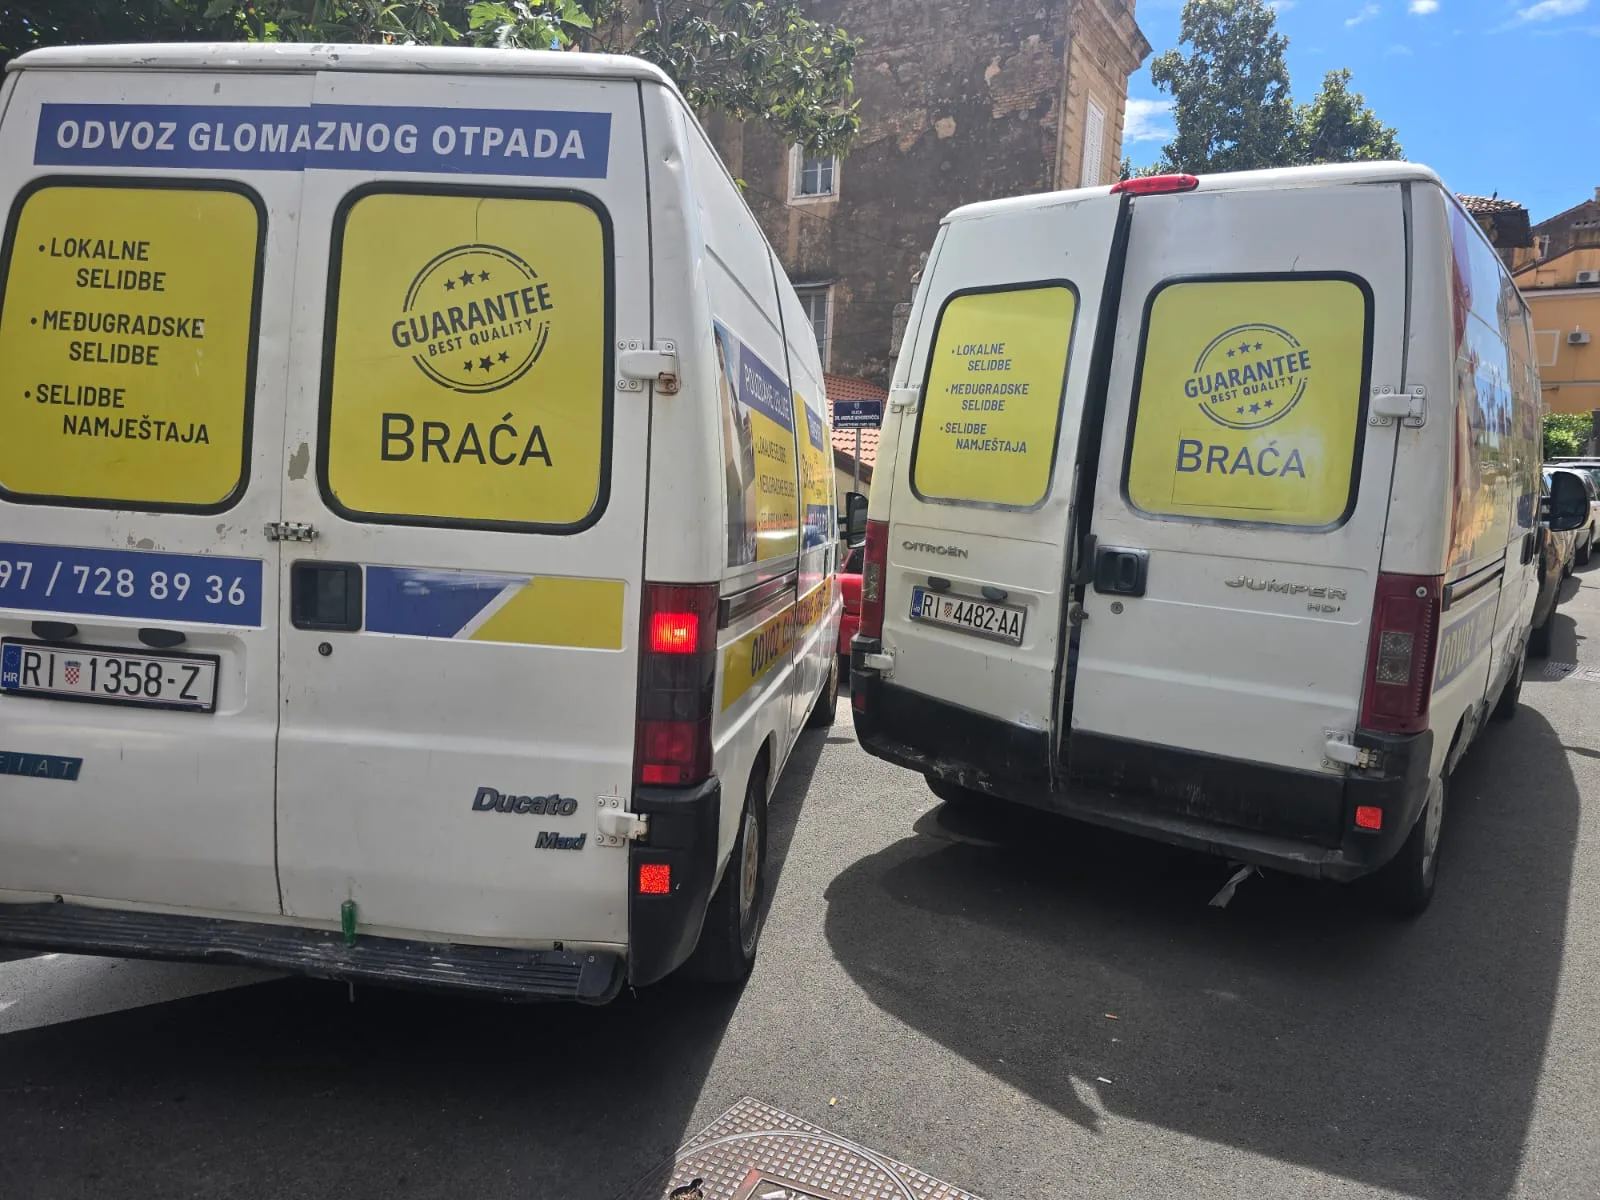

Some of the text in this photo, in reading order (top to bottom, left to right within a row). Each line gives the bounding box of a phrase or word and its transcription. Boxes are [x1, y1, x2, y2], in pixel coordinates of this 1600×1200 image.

[57, 120, 585, 160] ODVOZ GLOMAZNOG OTPADA
[50, 237, 150, 262] LOKALNE
[76, 267, 166, 292] SELIDBE
[42, 310, 205, 339] MEĐUGRADSKE
[391, 282, 553, 348] GUARANTEE
[428, 318, 533, 357] BEST QUALITY
[956, 342, 1006, 356] LOKALNE
[69, 341, 160, 366] SELIDBE
[967, 359, 1013, 371] SELIDBE
[1184, 349, 1312, 399] GUARANTEE
[36, 383, 126, 409] SELIDBE
[950, 383, 1030, 395] MEĐUGRADSKE
[1211, 375, 1294, 405] BEST QUALITY
[961, 399, 1006, 412] SELIDBE
[63, 414, 210, 444] NAMJEŠTAJA
[945, 422, 988, 435] SELIDBE
[956, 437, 1027, 453] NAMJEŠTAJA
[902, 540, 969, 559] CITROËN
[0, 561, 33, 590] 97
[73, 566, 135, 598] 728
[150, 571, 191, 601] 89
[205, 575, 246, 606] 36
[1224, 575, 1348, 600] JUMPER
[922, 594, 941, 618] RI
[3, 651, 201, 700] HR RI 1358-Z
[472, 786, 579, 816] Ducato
[534, 831, 588, 851] Maxi
